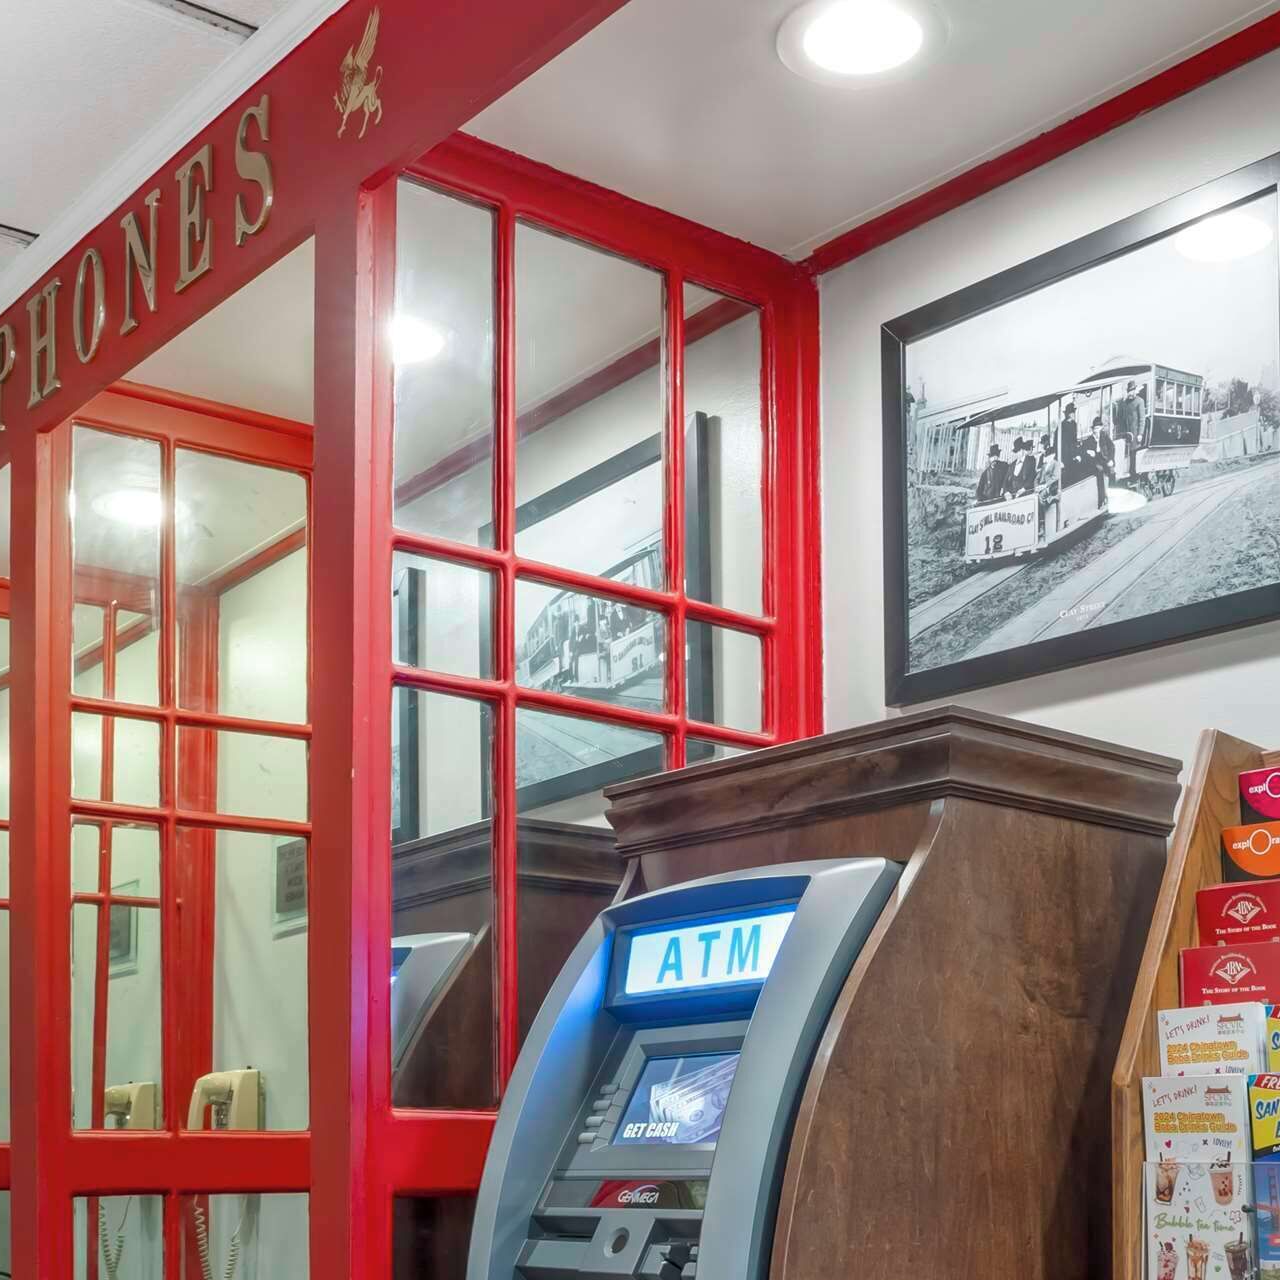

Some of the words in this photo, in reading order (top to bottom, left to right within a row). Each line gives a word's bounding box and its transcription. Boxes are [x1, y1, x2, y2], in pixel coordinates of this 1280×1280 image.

[984, 534, 1003, 554] 12
[656, 924, 761, 983] ATM
[1255, 1101, 1279, 1120] SAN
[623, 1123, 647, 1138] GET
[646, 1122, 679, 1138] CASH
